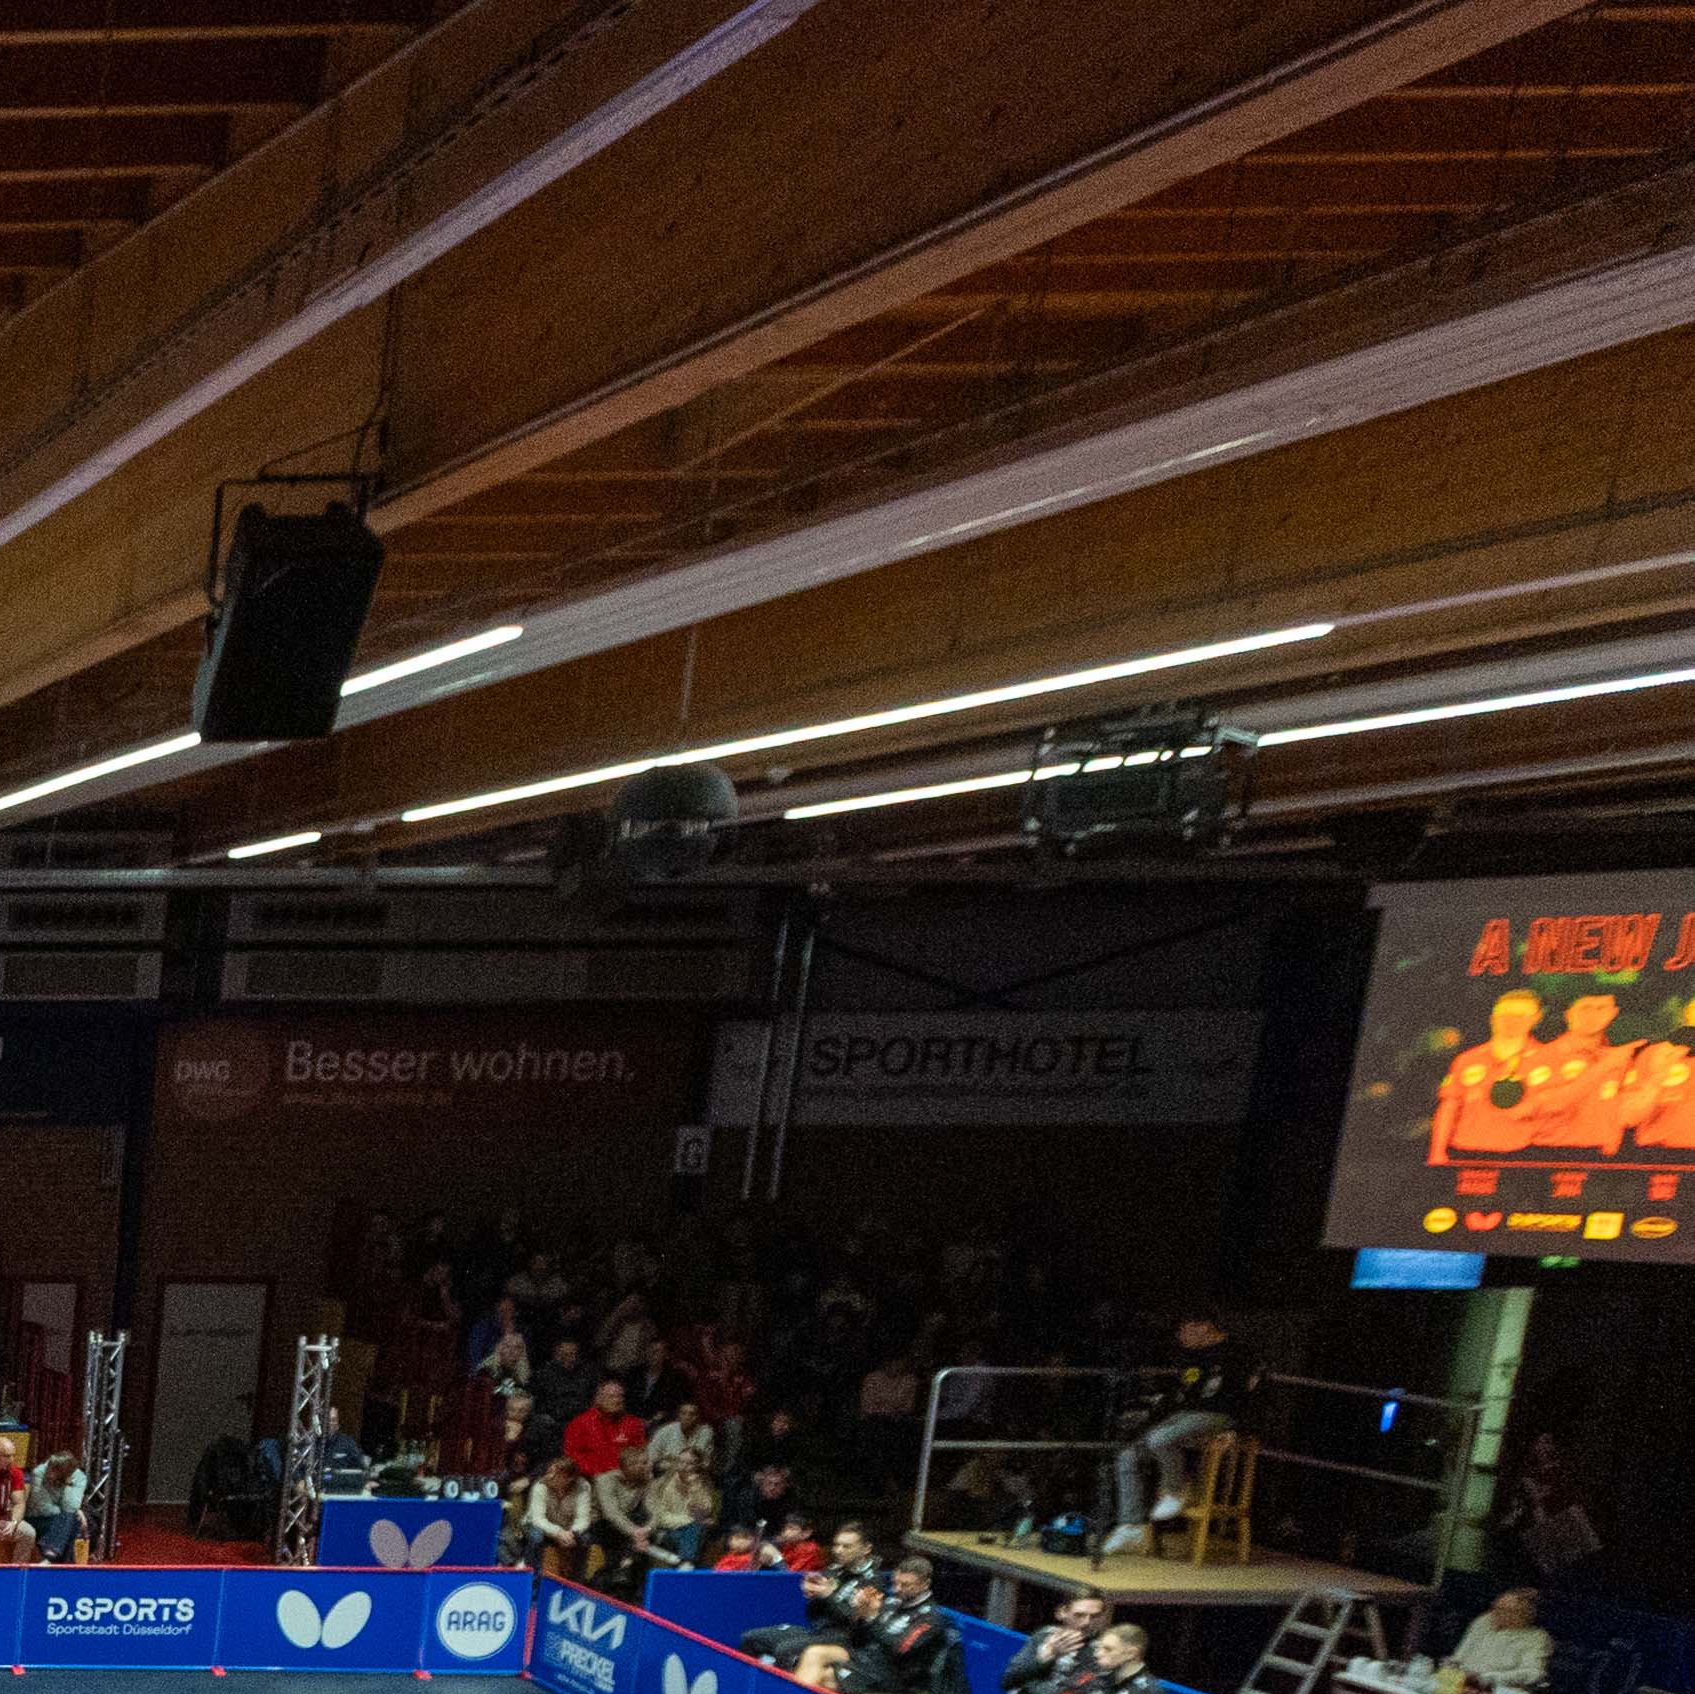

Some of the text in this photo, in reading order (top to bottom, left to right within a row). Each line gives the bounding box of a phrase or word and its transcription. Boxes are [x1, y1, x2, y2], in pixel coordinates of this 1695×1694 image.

[1467, 918, 1510, 976] A
[285, 1040, 637, 1085] Besser wohnen.
[812, 1036, 1155, 1078] SPORTHOTEL
[681, 1138, 704, 1170] G
[47, 1597, 196, 1622] D.SPORTS
[447, 1610, 507, 1632] ARAG
[47, 1622, 193, 1636] Sportstadt Düsseldorf
